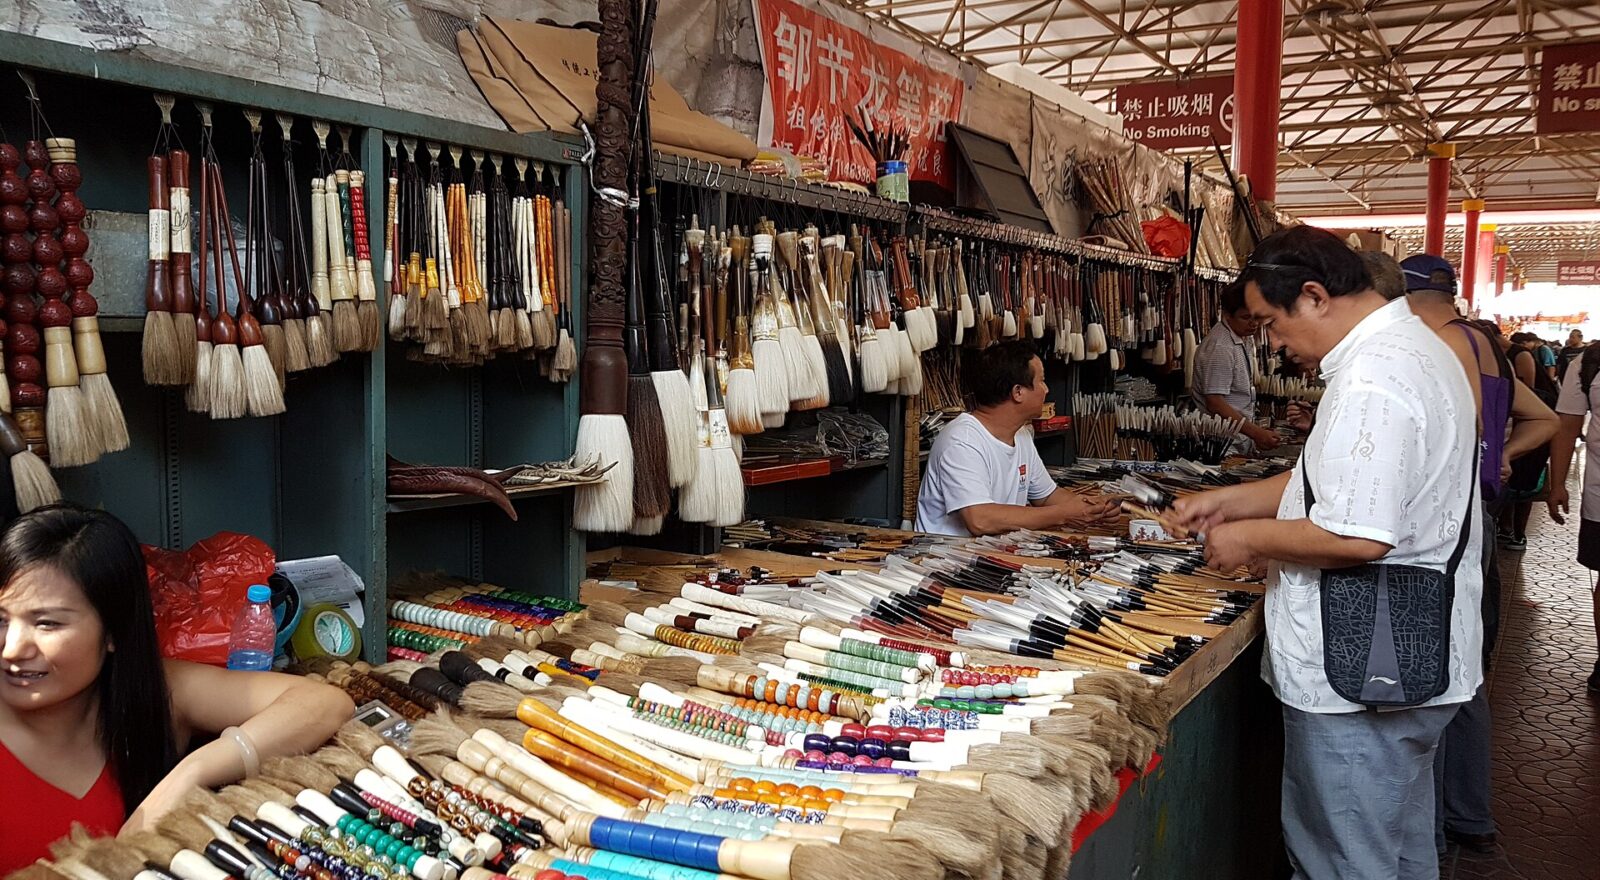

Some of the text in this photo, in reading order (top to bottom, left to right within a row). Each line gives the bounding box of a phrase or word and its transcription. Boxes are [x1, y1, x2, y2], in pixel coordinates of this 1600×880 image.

[1123, 92, 1213, 121] 禁止吸烟
[1552, 96, 1580, 113] No
[1123, 123, 1210, 140] No Smoking
